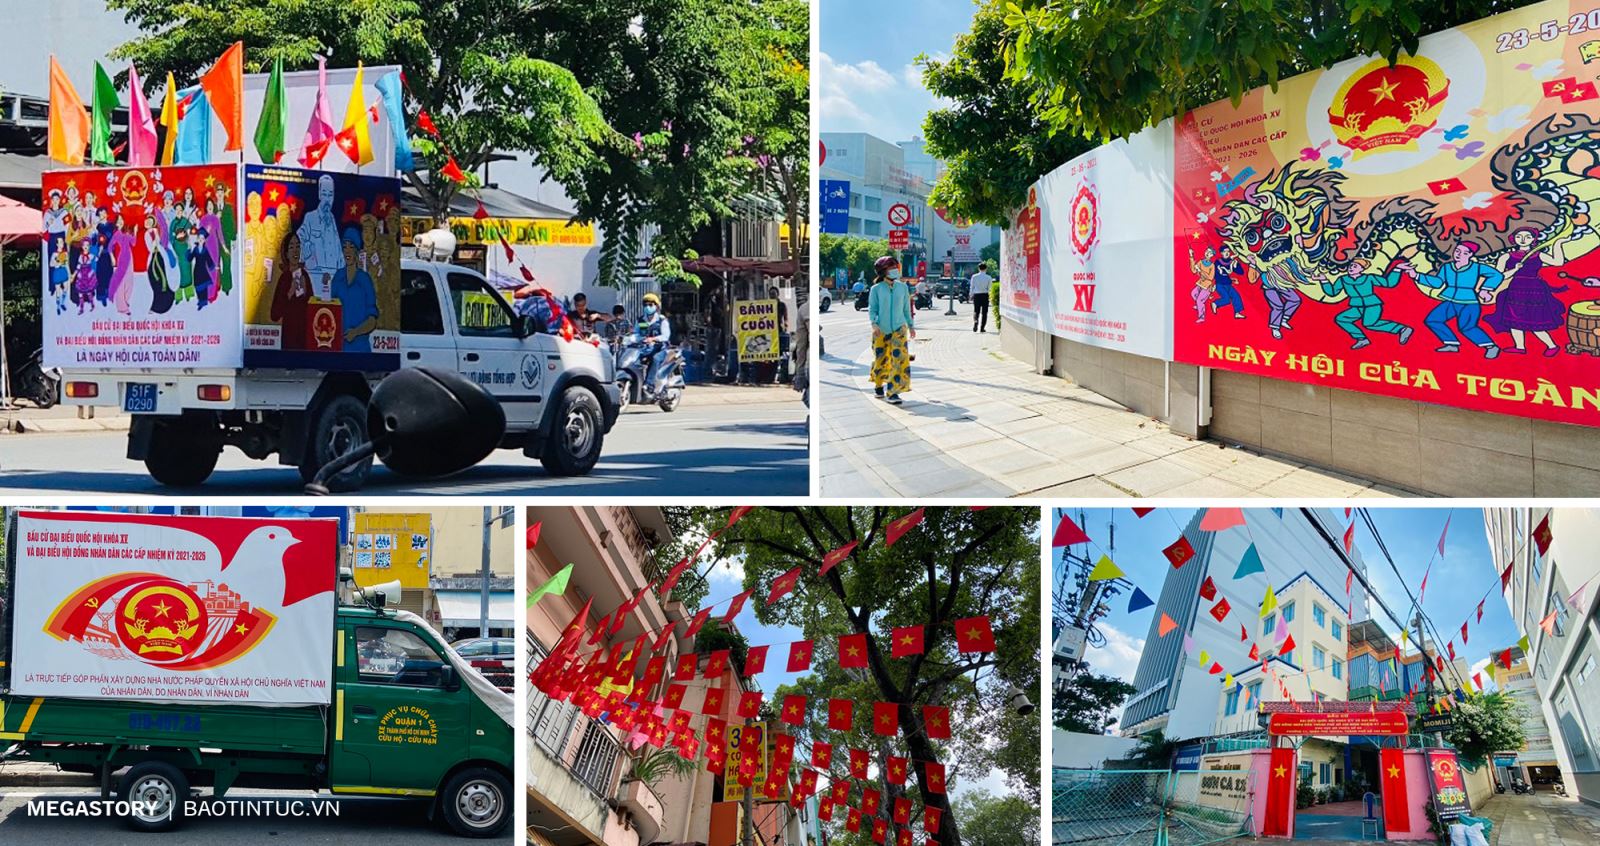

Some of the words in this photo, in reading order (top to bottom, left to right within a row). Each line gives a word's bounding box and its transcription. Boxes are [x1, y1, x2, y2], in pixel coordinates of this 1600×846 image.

[1270, 109, 1281, 118] XV
[1072, 284, 1097, 313] XV
[739, 302, 774, 315] BÁNH
[741, 316, 775, 330] CUỐN
[76, 348, 88, 362] LÀ
[89, 348, 113, 362] NGÀY
[115, 348, 130, 366] HỘI
[131, 346, 150, 362] CỦA
[152, 348, 177, 362] TOÀN
[1208, 344, 1277, 367] NGÀY
[1285, 353, 1345, 378] HỘI
[1359, 361, 1441, 391] CỦA
[1456, 373, 1600, 411] TOÀN
[132, 385, 151, 397] 51F
[128, 397, 153, 410] 0290
[27, 529, 39, 541] BẦU
[40, 528, 49, 542] CỬ
[61, 529, 74, 542] BIỂU
[75, 530, 91, 543] QUỐC
[92, 532, 102, 545] HỘI
[120, 534, 128, 544] XV
[27, 545, 34, 556] VÀ
[36, 547, 46, 559] ĐẠI
[47, 543, 60, 557] BIỂU
[62, 546, 72, 560] HỘI
[73, 545, 89, 557] ĐỒNG
[90, 546, 106, 558] NHÂN
[108, 547, 120, 558] DÂN
[121, 547, 133, 558] CÁC
[134, 546, 146, 559] CẤP
[147, 548, 166, 562] NHIỆM
[167, 548, 175, 560] KỲ
[176, 551, 206, 561] 2021-2026
[25, 674, 34, 682] LÀ
[36, 673, 55, 684] TRỰC
[56, 672, 71, 683] TIẾP
[73, 673, 89, 683] GÓP
[110, 674, 124, 684] XÂY
[125, 675, 146, 685] DỰNG
[147, 675, 161, 684] NHÀ
[163, 675, 184, 685] NƯỚC
[185, 675, 203, 685] PHÁP
[204, 676, 229, 686] QUYỀN
[230, 677, 239, 686] XÃ
[241, 677, 253, 688] HỘI
[254, 676, 270, 687] CHỦ
[271, 678, 292, 687] NGHĨA
[294, 678, 309, 688] VIỆT
[310, 679, 326, 689] NAM
[101, 685, 116, 695] CỦA
[117, 687, 136, 695] NHÂN
[155, 688, 166, 696] DO
[167, 688, 187, 697] NHÂN
[214, 688, 233, 698] NHÂN
[234, 689, 249, 698] DÂN
[398, 705, 409, 714] VỤ
[395, 717, 417, 727] QUẬN
